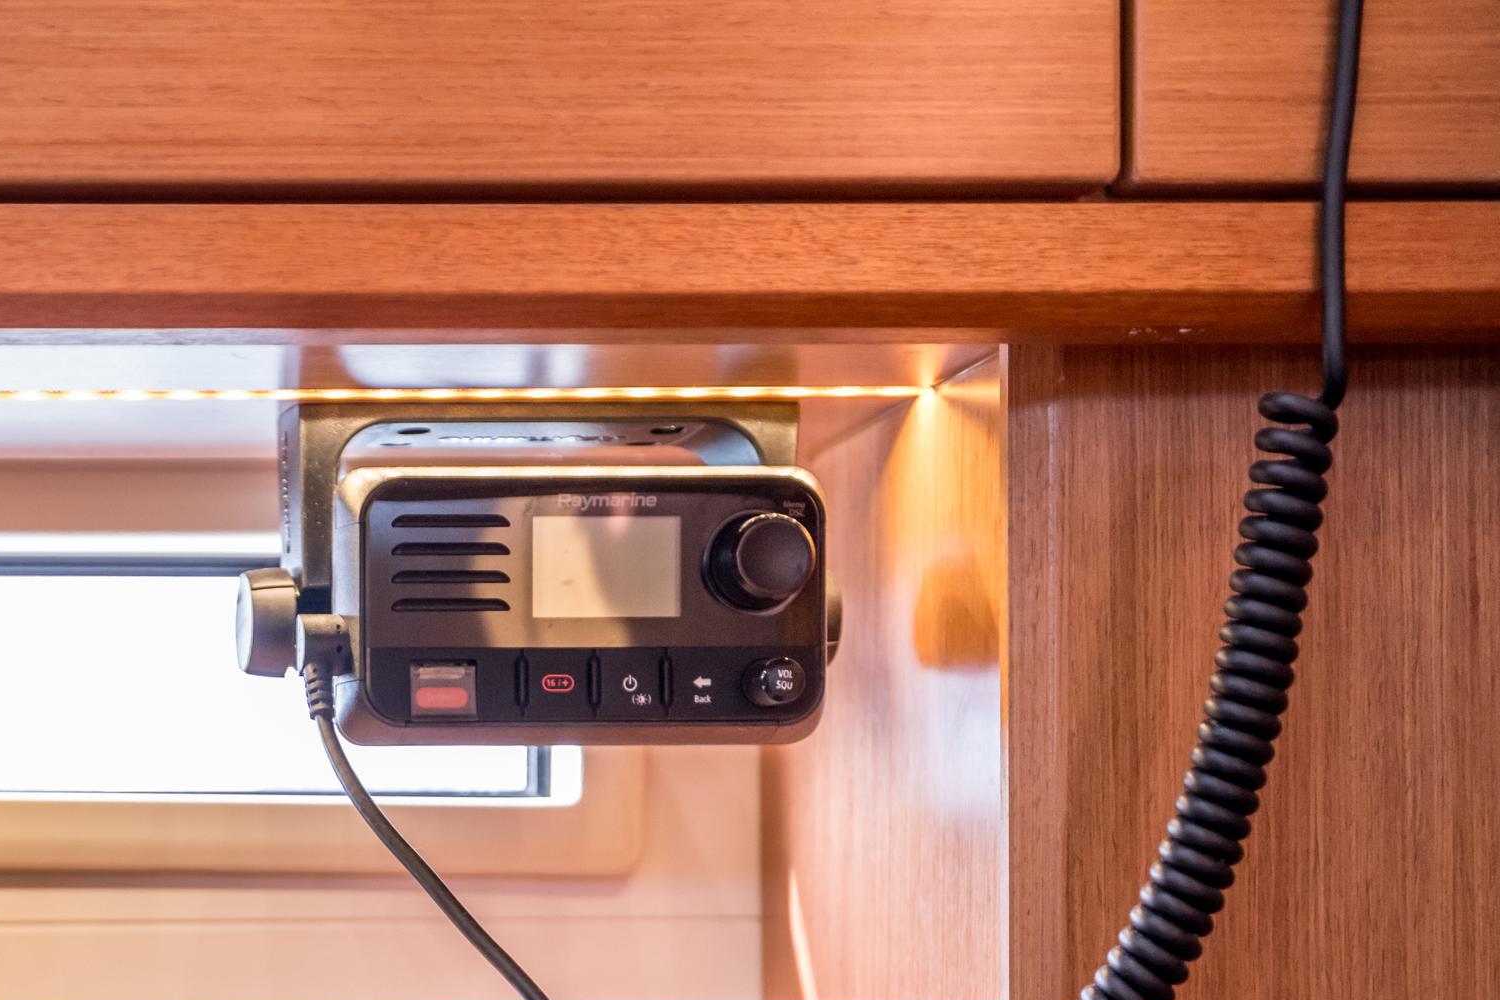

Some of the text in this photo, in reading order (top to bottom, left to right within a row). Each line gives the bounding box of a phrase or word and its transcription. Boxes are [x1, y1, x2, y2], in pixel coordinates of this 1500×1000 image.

[557, 492, 658, 511] Raymarine
[777, 669, 793, 678] VOL
[694, 694, 711, 703] Back
